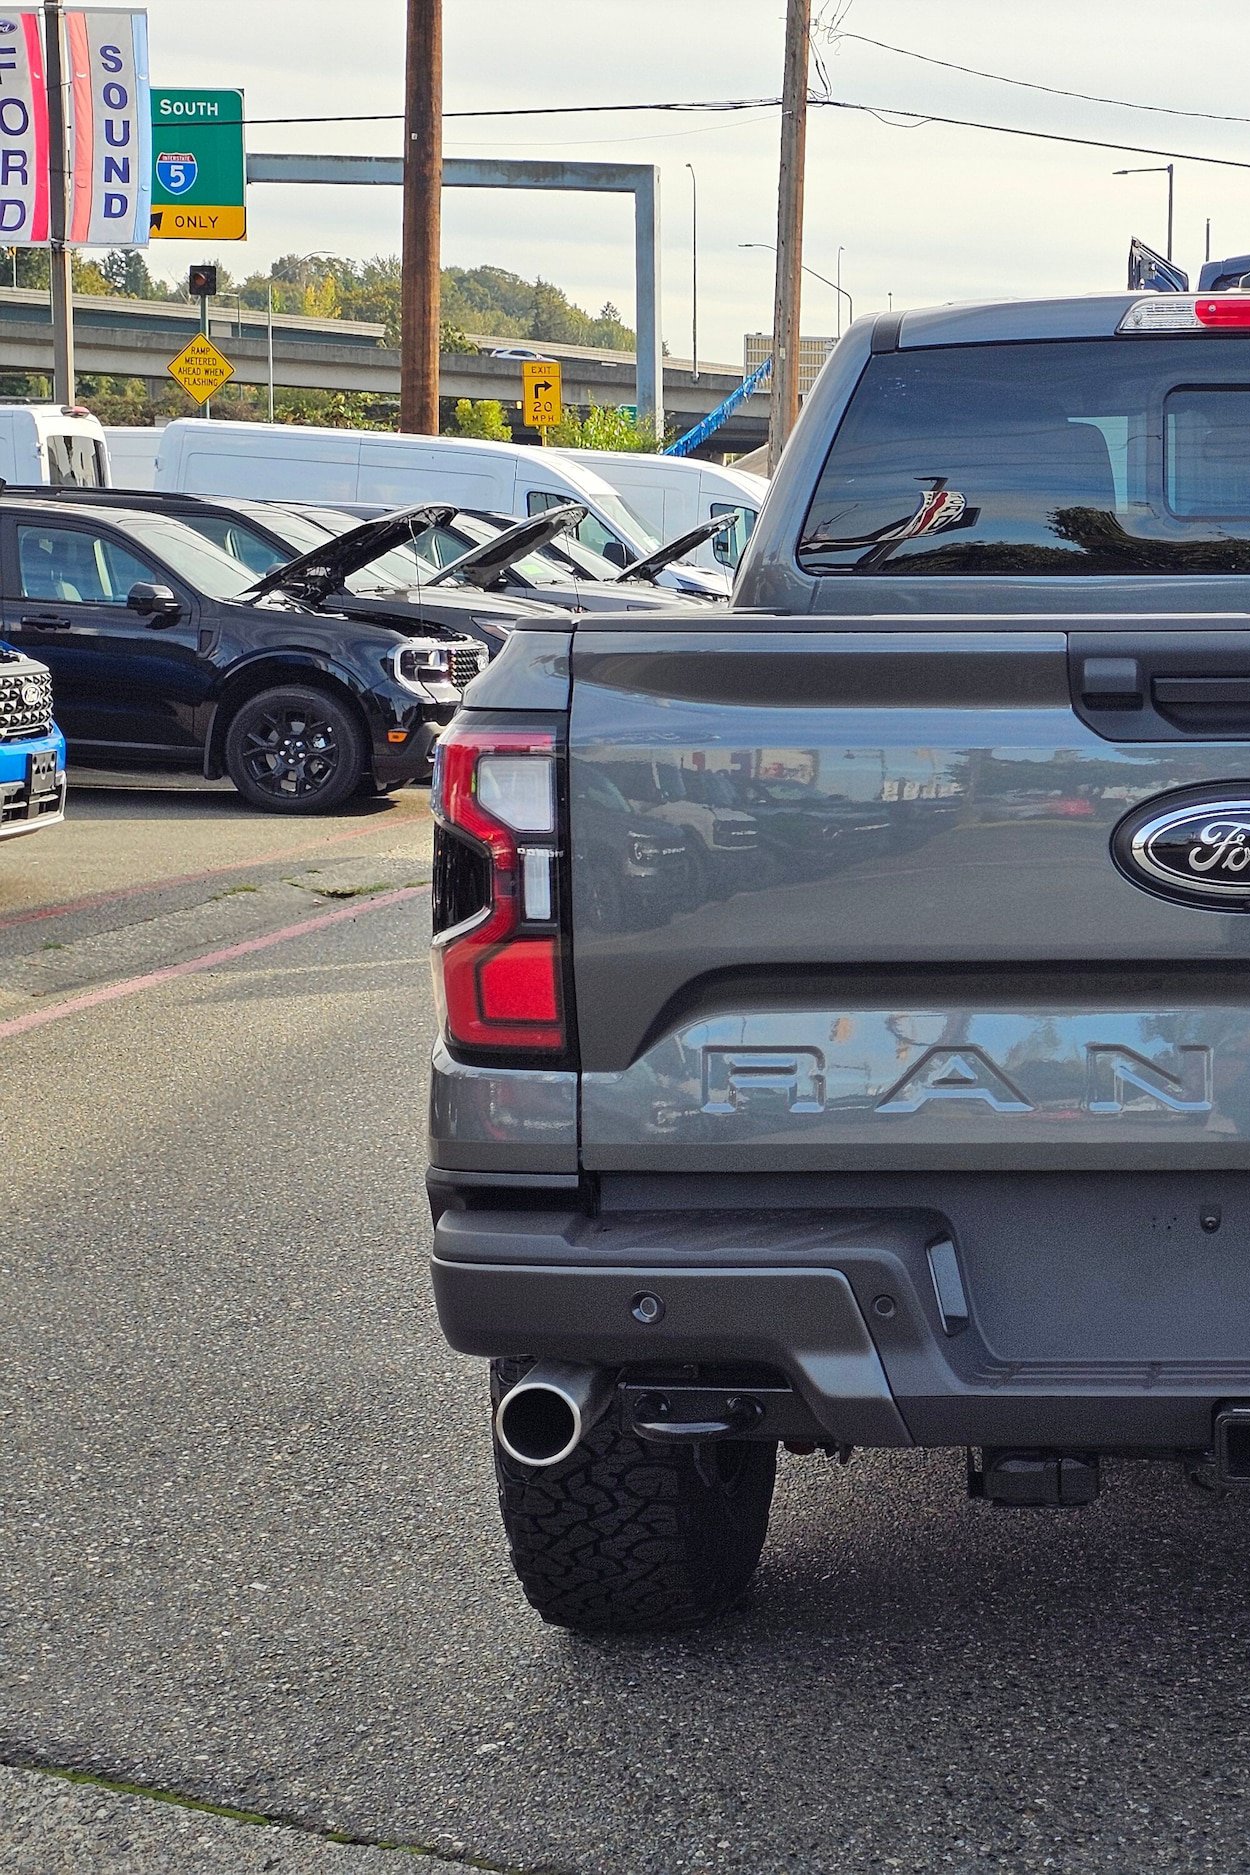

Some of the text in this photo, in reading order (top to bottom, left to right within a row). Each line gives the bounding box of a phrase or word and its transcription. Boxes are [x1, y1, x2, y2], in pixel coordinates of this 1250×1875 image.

[159, 99, 219, 117] SOUTH
[99, 45, 130, 219] SOUND
[170, 164, 186, 188] 5
[175, 215, 219, 229] ONLY
[191, 346, 210, 355] RAMP
[184, 357, 217, 366] METERED
[178, 367, 225, 377] AHEAD WHEN
[531, 366, 552, 374] EXIT
[184, 377, 218, 387] FLASHING
[533, 401, 553, 413] 20
[532, 414, 554, 422] MPH
